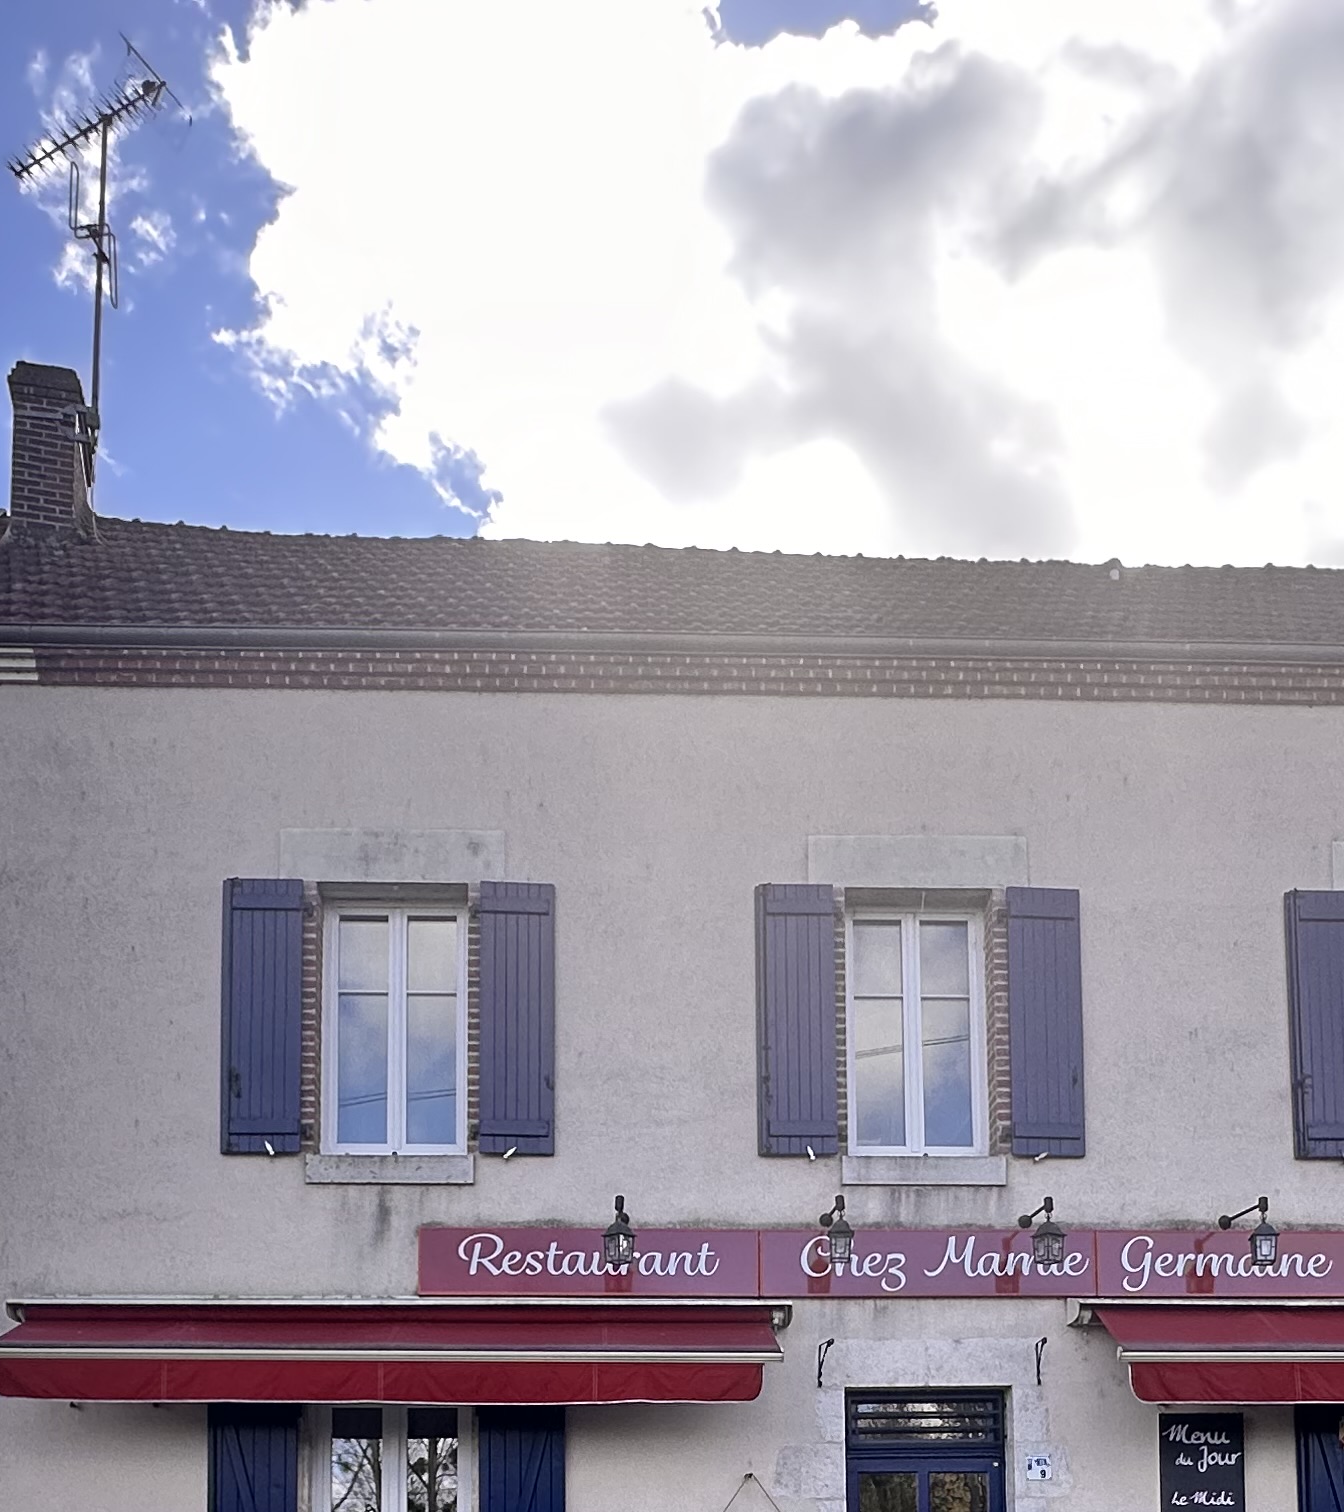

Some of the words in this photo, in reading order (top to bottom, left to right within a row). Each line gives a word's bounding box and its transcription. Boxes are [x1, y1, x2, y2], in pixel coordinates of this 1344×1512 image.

[458, 1233, 719, 1276] Restaurant
[800, 1235, 907, 1292] Chez
[1161, 1423, 1231, 1444] Menu
[1175, 1452, 1194, 1466] du
[1197, 1445, 1242, 1473] Jour
[1039, 1469, 1047, 1479] 9
[1171, 1491, 1189, 1506] Le
[1189, 1490, 1235, 1506] Midi
